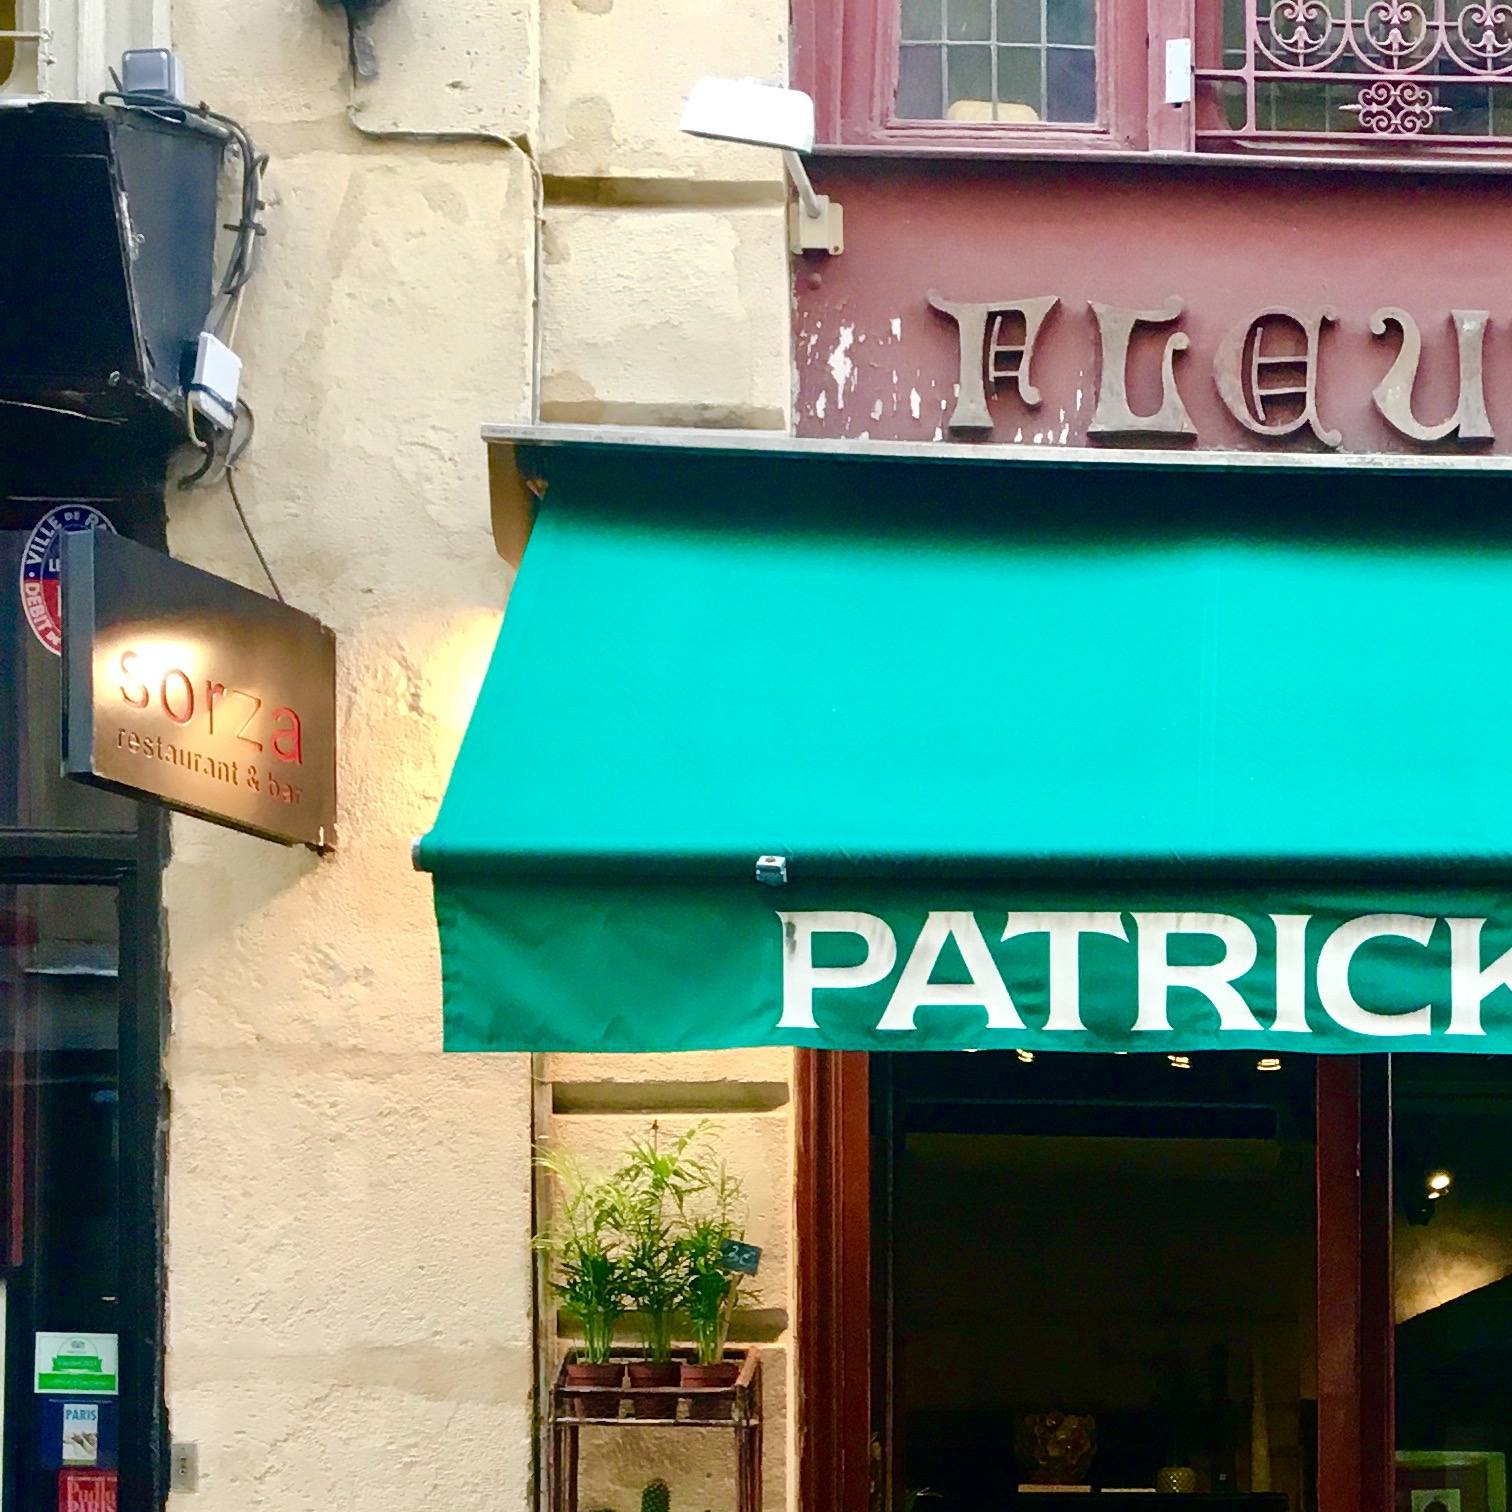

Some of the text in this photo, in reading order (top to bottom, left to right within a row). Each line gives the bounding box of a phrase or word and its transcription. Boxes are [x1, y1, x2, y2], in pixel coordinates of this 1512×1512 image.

[26, 514, 63, 565] VILLE
[117, 726, 303, 805] restaurant & bar
[65, 1409, 97, 1421] PARIS
[68, 1480, 116, 1503] Pudlo
